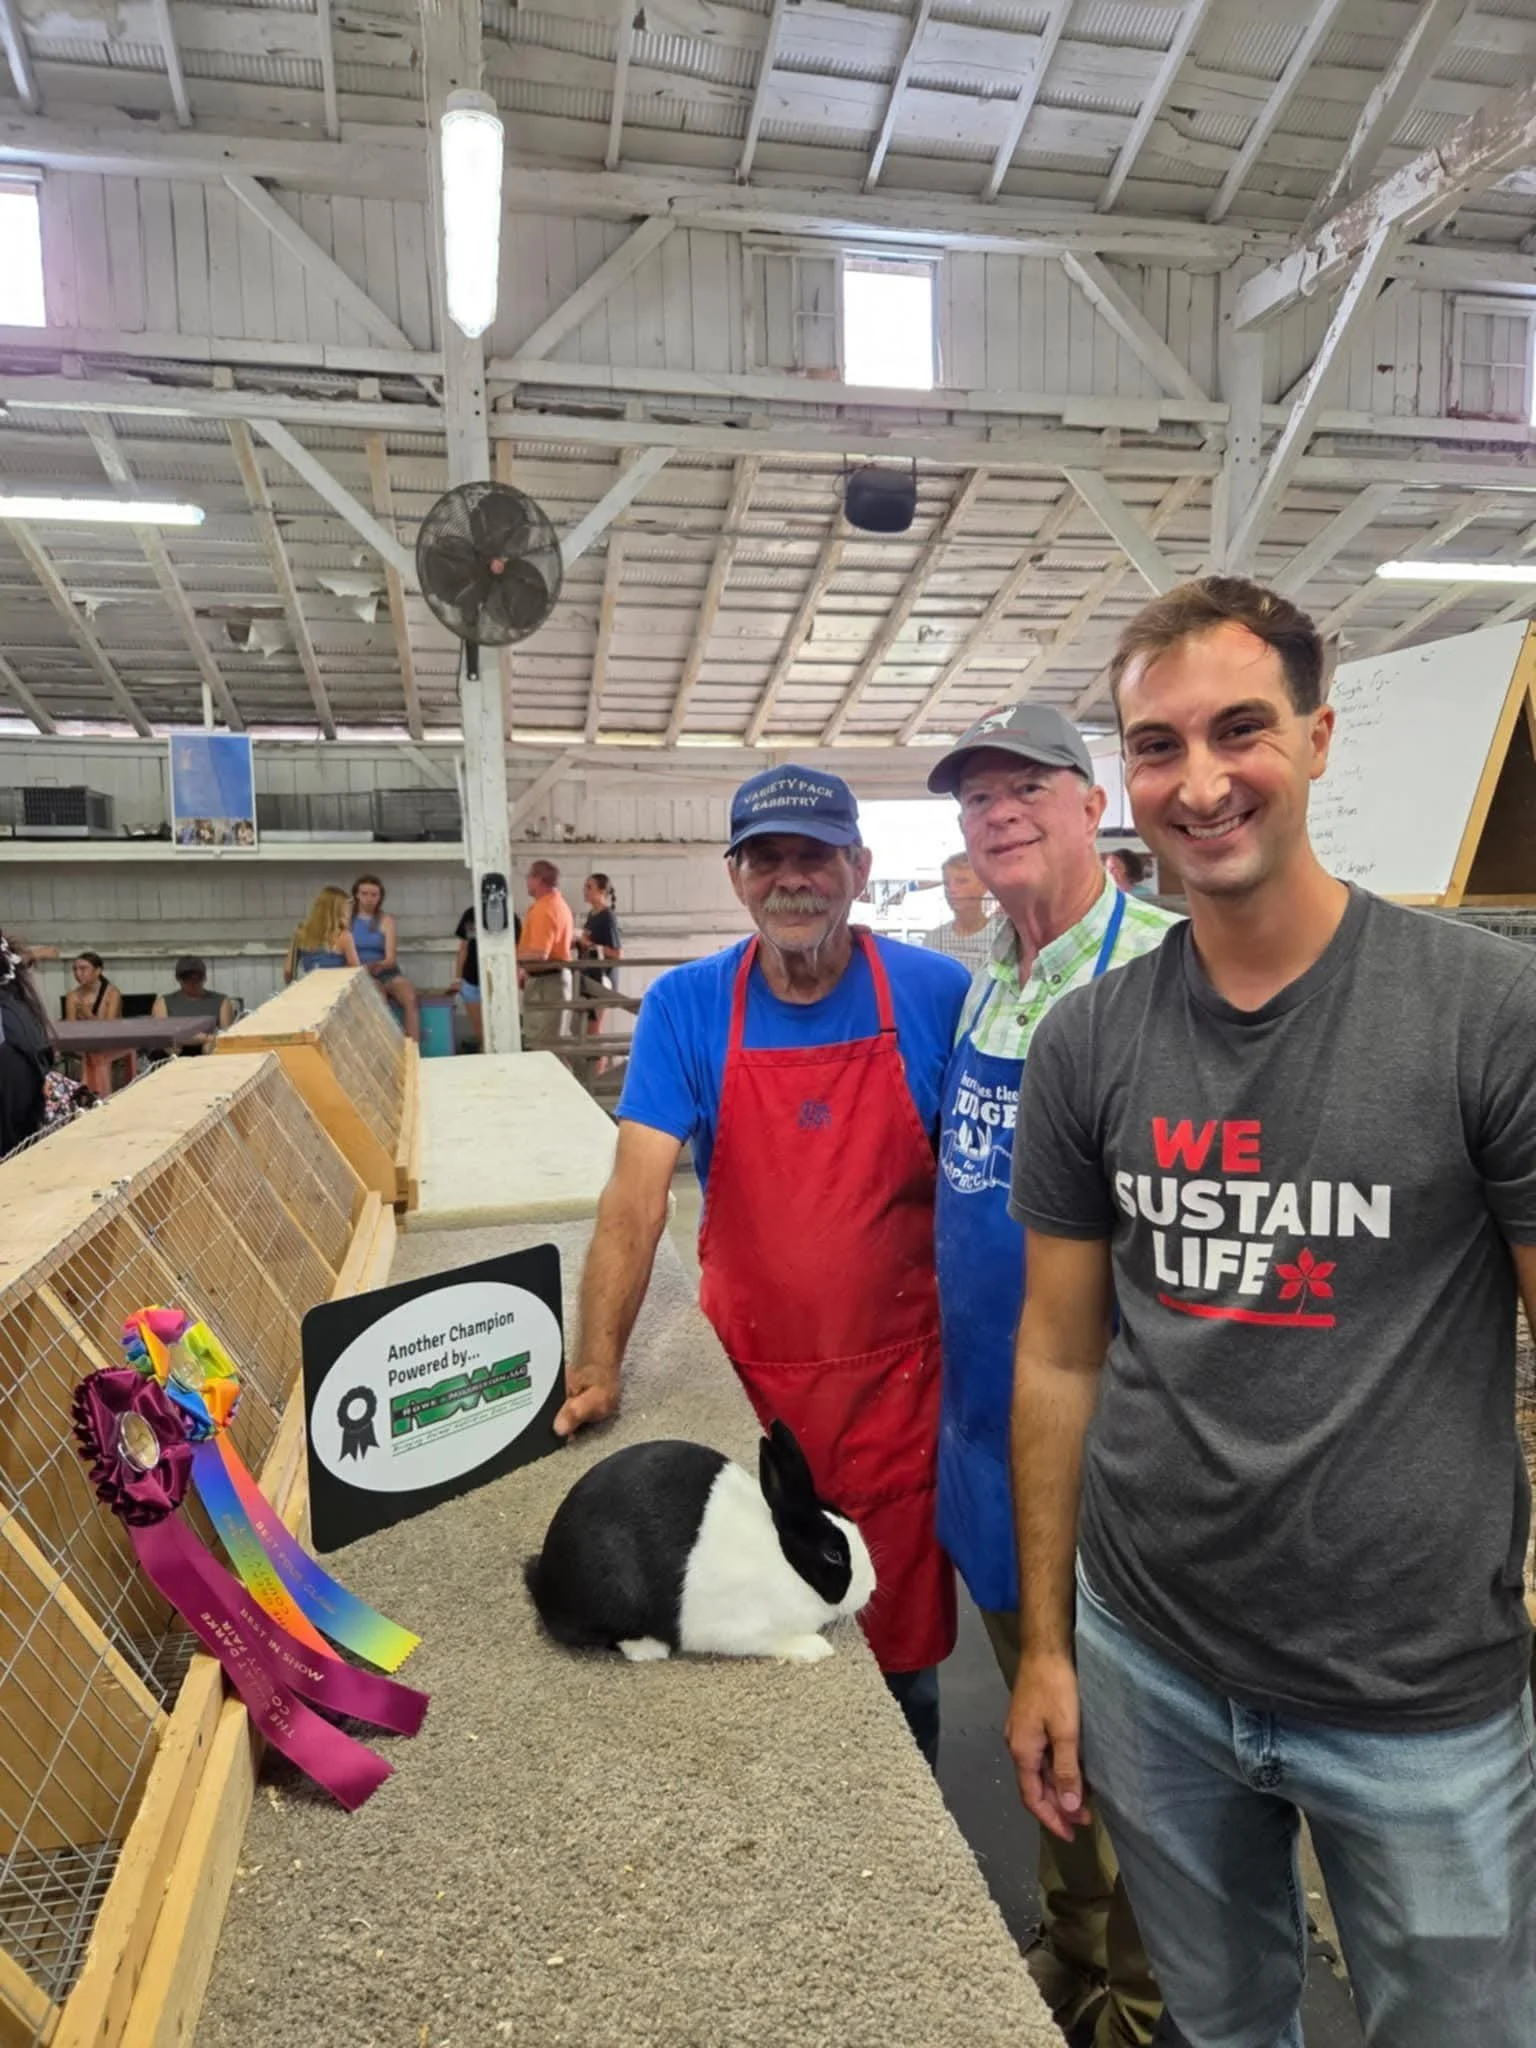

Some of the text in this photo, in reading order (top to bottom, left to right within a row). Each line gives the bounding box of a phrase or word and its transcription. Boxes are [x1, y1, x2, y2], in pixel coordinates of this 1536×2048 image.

[743, 777, 834, 804] VARIETY PACK
[752, 796, 819, 812] RABBITRY
[1152, 1116, 1261, 1173] WE
[1115, 1170, 1391, 1239] SUSTAIN
[1152, 1230, 1274, 1295] LIFE
[387, 1312, 515, 1362] Another Champion
[388, 1350, 480, 1387] Powered by...
[200, 1611, 240, 1658] DARKE
[221, 1620, 249, 1653] FAIR
[240, 1607, 324, 1682] BEST IN SHOW
[269, 1713, 296, 1739] THE
